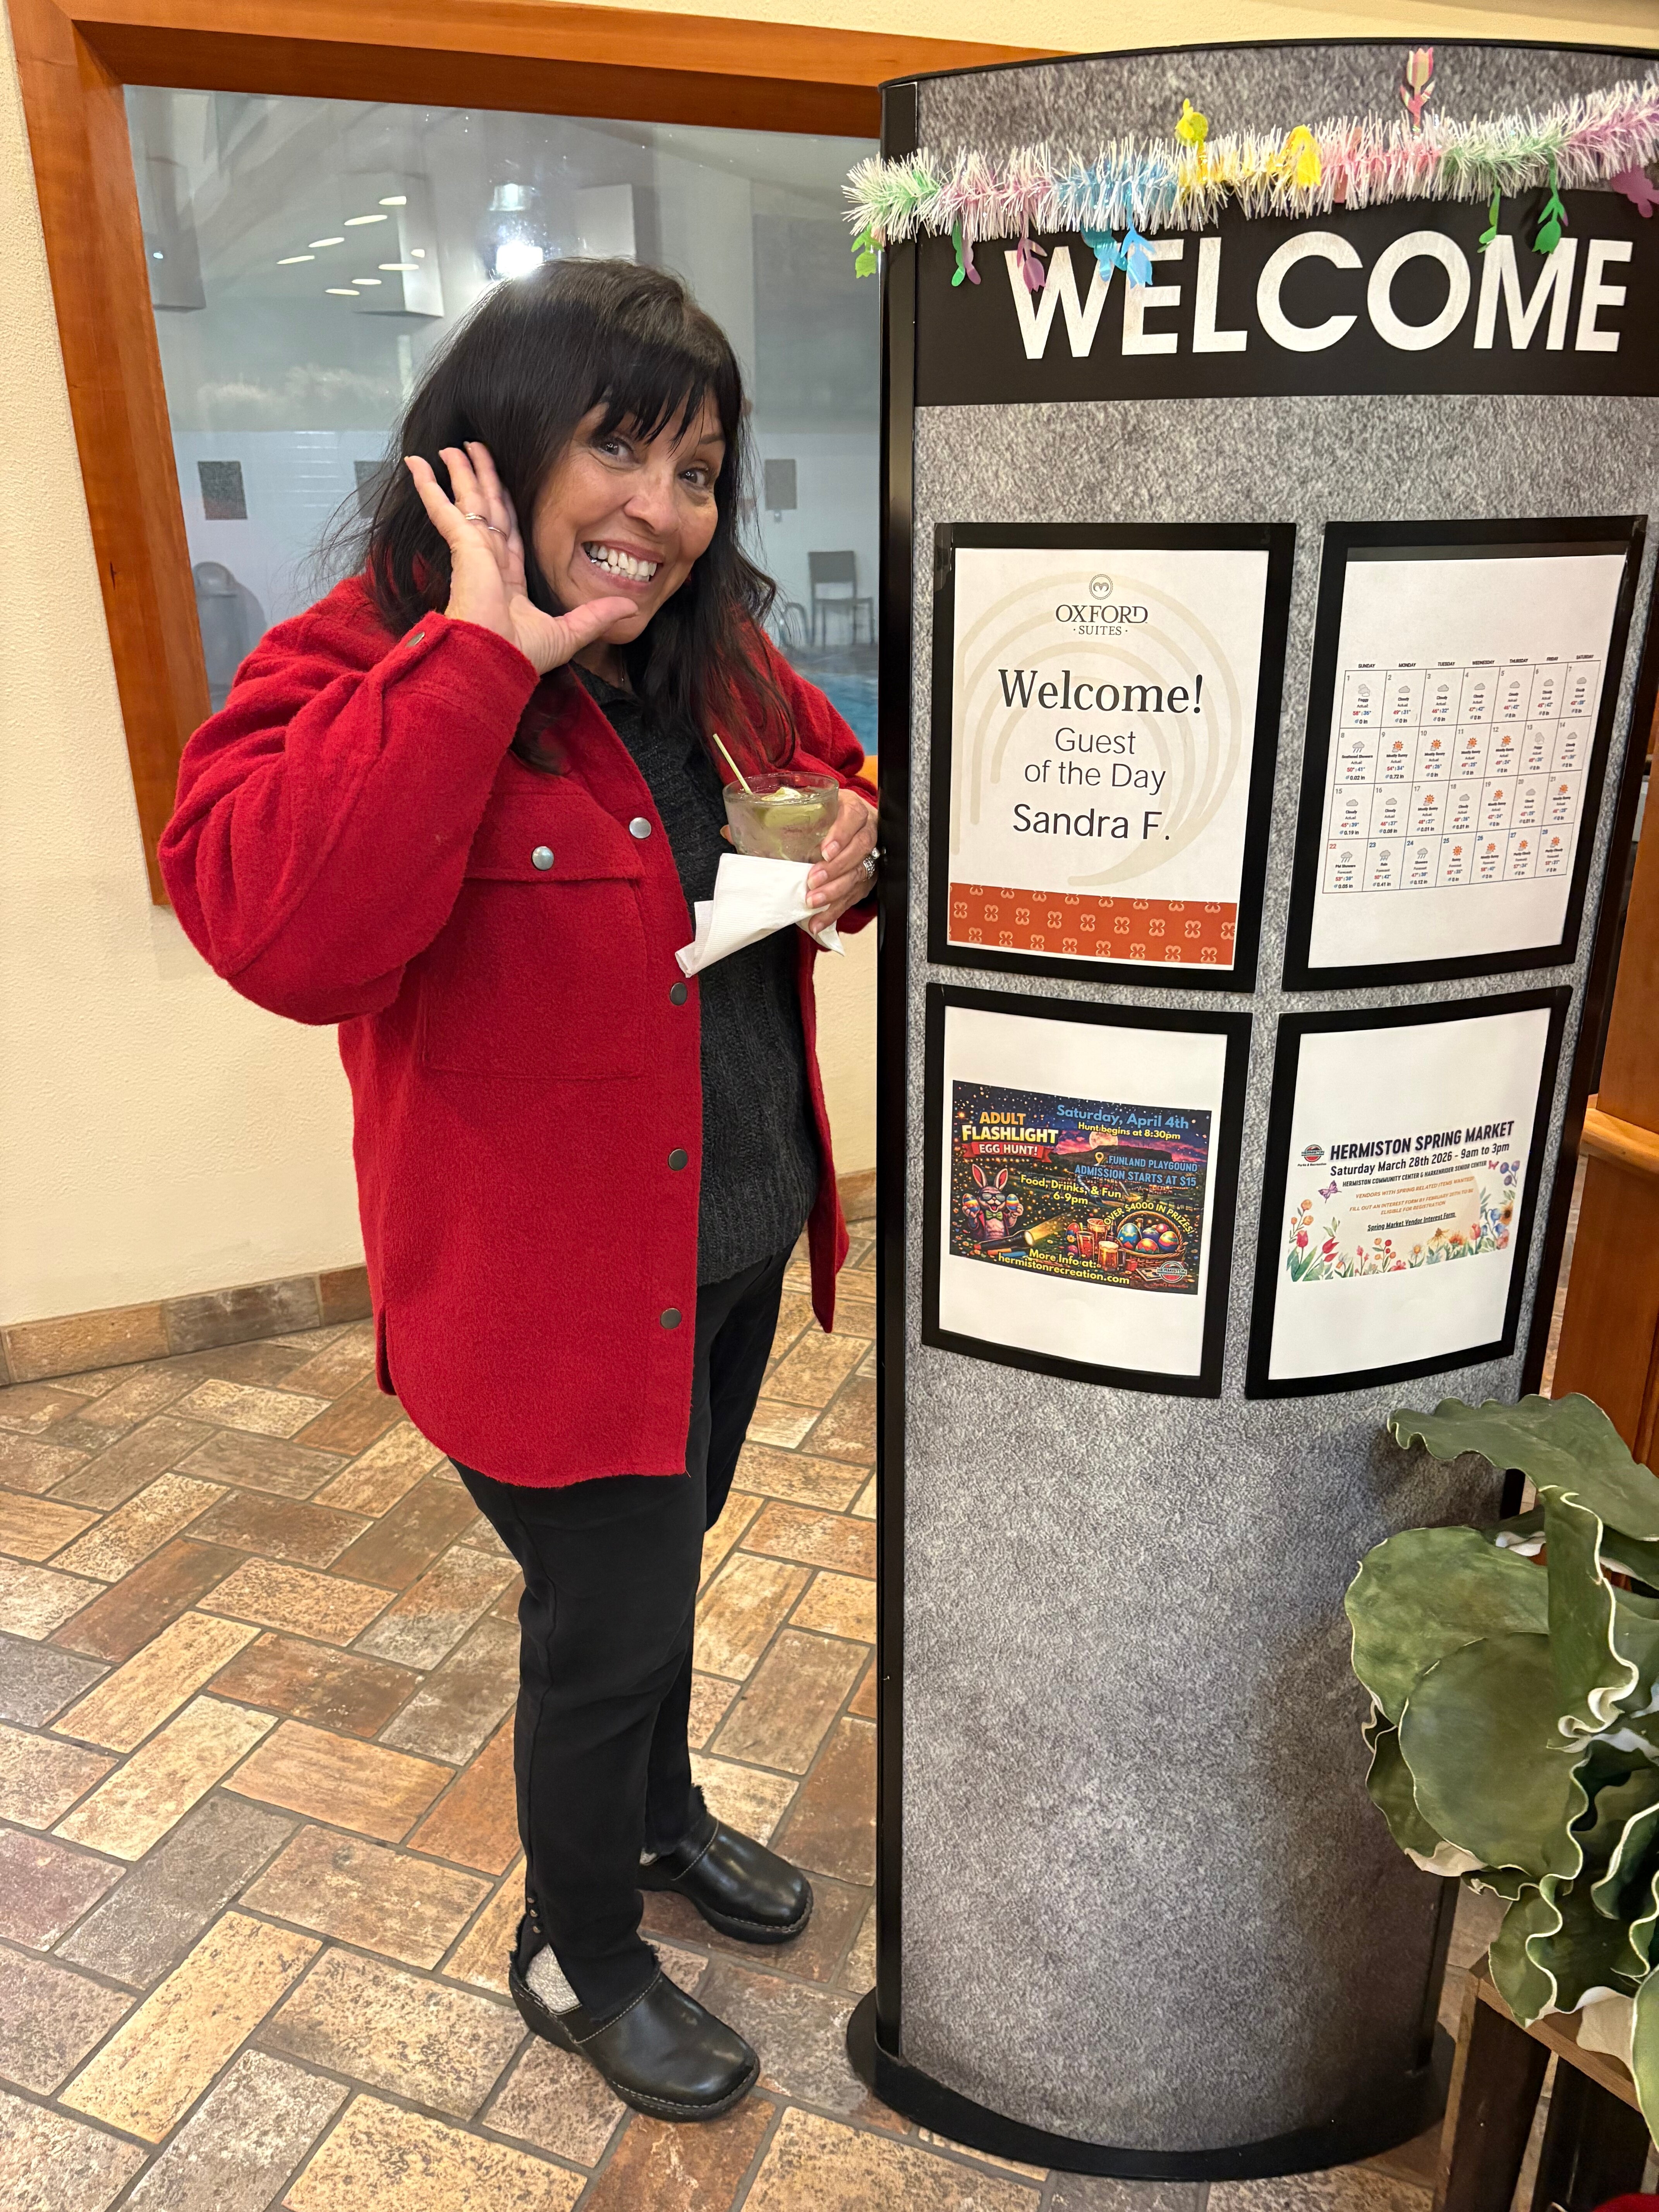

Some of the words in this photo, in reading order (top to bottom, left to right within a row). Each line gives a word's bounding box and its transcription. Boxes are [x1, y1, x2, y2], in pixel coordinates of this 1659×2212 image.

[1004, 230, 1633, 360] WELCOME
[1056, 605, 1148, 623] OXFORD
[1079, 625, 1121, 635] SUITES
[998, 669, 1203, 713] Welcome!
[1055, 728, 1136, 754] Guest
[1025, 759, 1051, 783] of
[1059, 761, 1101, 786] the
[1111, 763, 1166, 795] Day
[1013, 804, 1128, 838] Sandra
[1143, 811, 1169, 840] F.
[979, 1112, 1026, 1125] ADULT
[1056, 1104, 1123, 1126] Saturday,
[1127, 1113, 1161, 1128] April
[1164, 1116, 1188, 1129] 4th
[962, 1125, 1059, 1144] FLASHLIGHT
[1078, 1121, 1099, 1131] Hunt
[1101, 1124, 1130, 1136] begins
[1144, 1129, 1180, 1140] 8:30pm
[1330, 1137, 1411, 1160] HERMISTON
[1415, 1130, 1462, 1151] SPRING
[1465, 1121, 1514, 1142] MARKET
[979, 1144, 1000, 1153] EGG
[1003, 1144, 1037, 1156] HUNT!
[1330, 1163, 1376, 1176] Saturday
[1378, 1159, 1406, 1171] March
[1409, 1156, 1429, 1167] 28th
[1431, 1152, 1452, 1164] 2026
[1461, 1149, 1478, 1159] 9am
[1482, 1146, 1489, 1154] to
[1492, 1143, 1510, 1155] 3pm
[1108, 1155, 1146, 1167] FUNLAND
[1148, 1159, 1197, 1172] PLAYGOUND
[1020, 1175, 1048, 1188] Food,
[1051, 1180, 1087, 1195] Drinks,
[1091, 1186, 1099, 1195] &
[1102, 1187, 1121, 1198] Fun
[1075, 1164, 1125, 1180] ADMISSION
[1128, 1171, 1163, 1183] STARTS
[1166, 1176, 1177, 1185] AT
[1180, 1176, 1196, 1187] $15
[1372, 1175, 1401, 1184] COMMUNITY
[1402, 1172, 1419, 1180] CENTER
[1424, 1167, 1454, 1177] HARKENRIDER
[1053, 1192, 1088, 1205] 6-9pm
[1104, 1208, 1125, 1225] OVER
[1125, 1202, 1154, 1212] $4000
[1156, 1204, 1166, 1213] IN
[1166, 1209, 1195, 1234] PRIZES!
[1367, 1223, 1385, 1231] Spring
[1386, 1221, 1404, 1229] Market
[1424, 1214, 1443, 1223] Interest
[998, 1252, 1130, 1284] hermistonrecreation.com
[1029, 1249, 1056, 1262] More
[1059, 1254, 1079, 1266] Info
